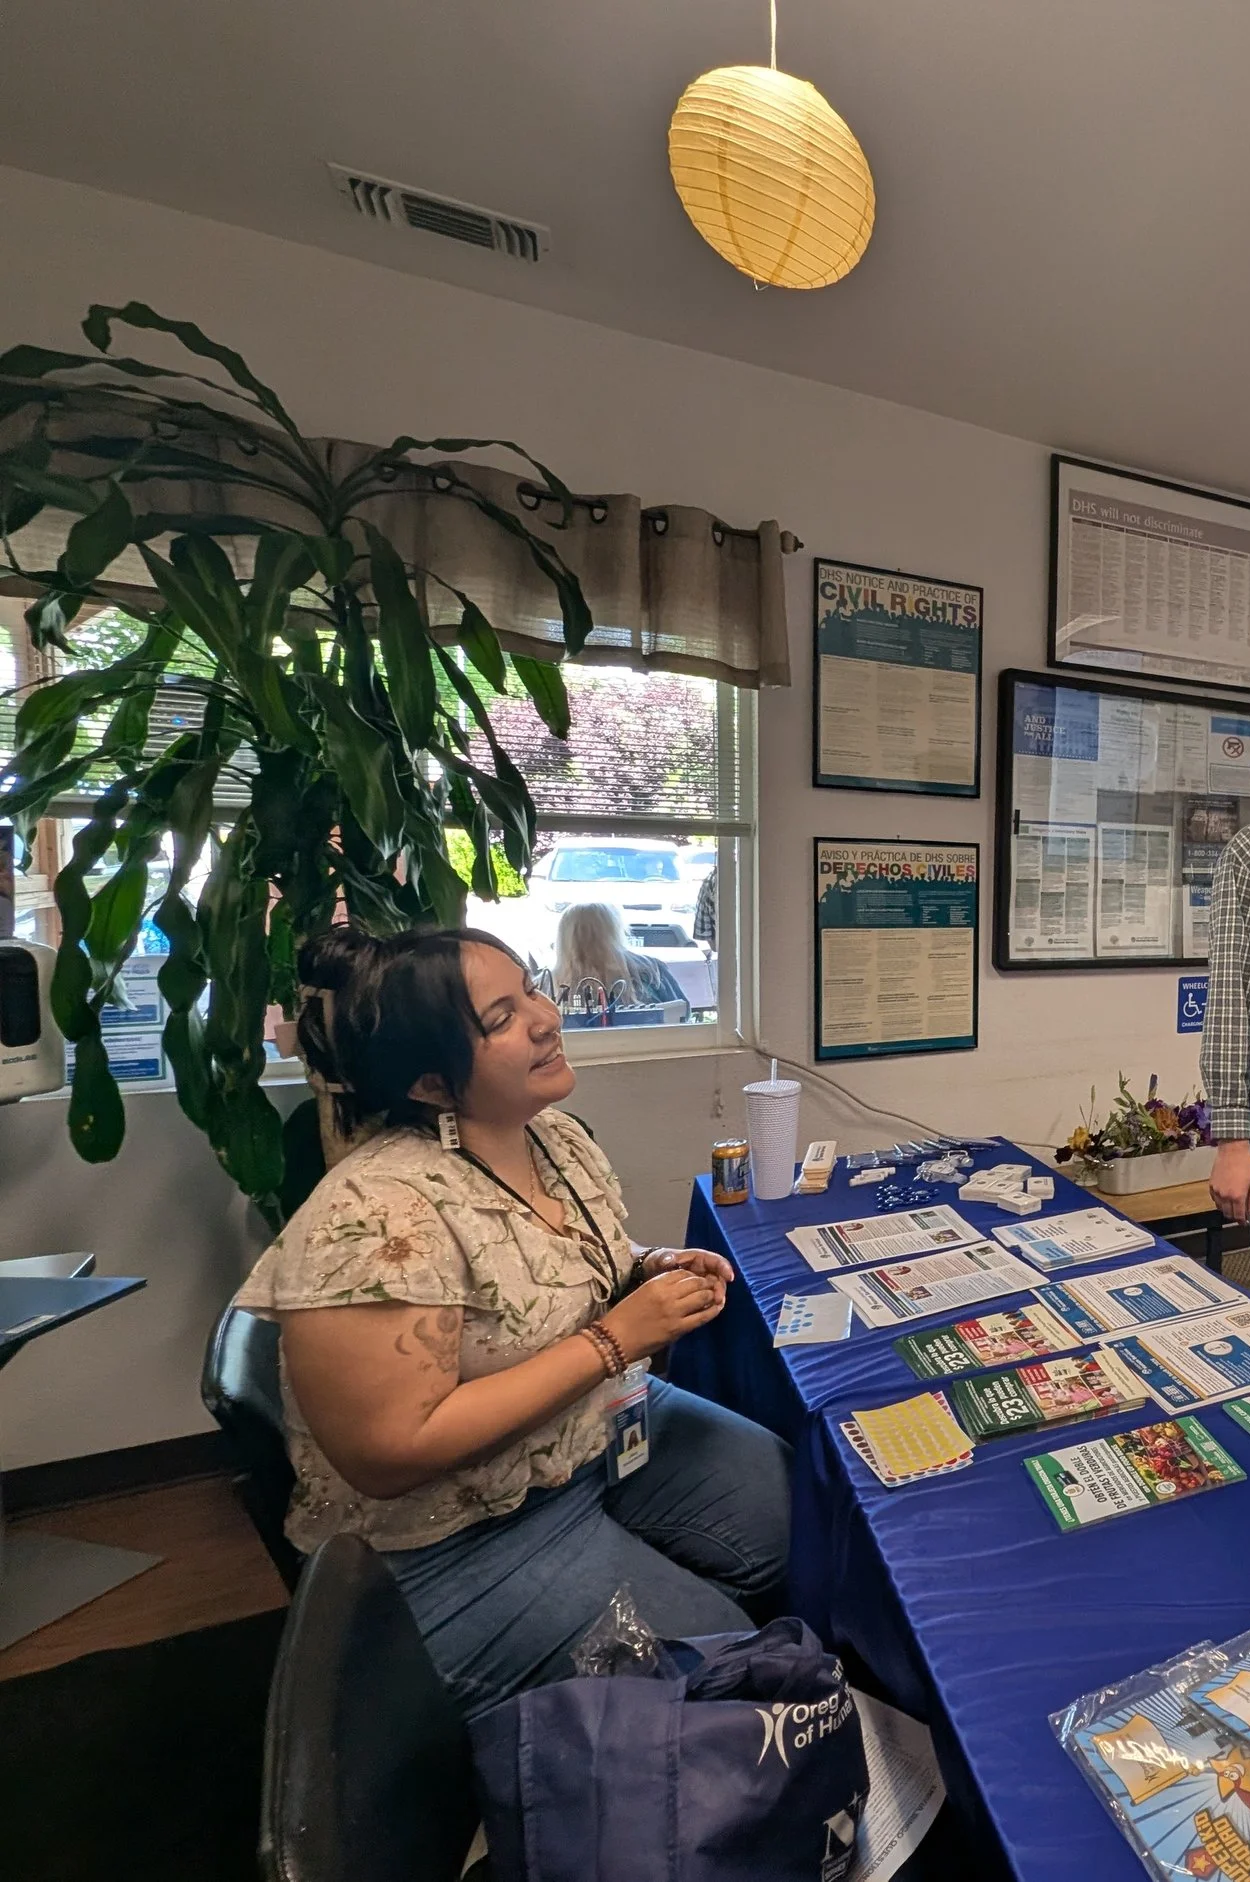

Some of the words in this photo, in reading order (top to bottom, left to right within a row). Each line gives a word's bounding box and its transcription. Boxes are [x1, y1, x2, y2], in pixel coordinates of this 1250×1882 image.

[1073, 498, 1096, 515] DHS
[1101, 506, 1119, 520] will
[1123, 511, 1140, 526] not
[1144, 517, 1204, 539] discriminate
[820, 568, 842, 582] DHS
[846, 572, 884, 589] NOTICE
[887, 580, 909, 593] AND
[913, 584, 960, 602] PRACTICE
[964, 593, 977, 604] OF
[820, 582, 884, 610] CIVIL
[891, 593, 977, 623] RIGHTS
[1024, 715, 1046, 724] AND
[1024, 724, 1065, 734] JUSTICE
[821, 850, 849, 860] AVISO
[852, 850, 857, 859] Y
[861, 849, 907, 861] PRÁCTICA
[910, 852, 922, 862] DE
[925, 852, 943, 863] DHS
[947, 853, 975, 863] SOBRE
[821, 862, 912, 877] DERECHOS
[917, 863, 975, 877] CIVILES
[1191, 885, 1212, 895] Weapo
[925, 1344, 936, 1352] que
[933, 1338, 949, 1353] pueden
[941, 1334, 957, 1351] comprar
[934, 1356, 951, 1374] Descubra
[944, 1352, 969, 1369] $23
[983, 1387, 994, 1397] que
[992, 1381, 1008, 1399] pueden
[1001, 1376, 1017, 1397] comprar
[991, 1402, 1009, 1424] Descubra
[1001, 1398, 1028, 1420] $23
[1070, 1456, 1089, 1475] DOBLE
[1077, 1445, 1102, 1474] VERDURAS
[1082, 1474, 1094, 1482] EL
[1111, 1475, 1128, 1495] MERCADOS
[1130, 1470, 1145, 1486] DOUBLE
[1087, 1482, 1107, 1502] OBTÉN
[1099, 1477, 1120, 1499] FRUTAS
[1126, 1482, 1140, 1498] PUESTOS
[1113, 1499, 1126, 1509] DE
[792, 1692, 838, 1725] Oreg
[794, 1726, 813, 1749] of
[820, 1699, 853, 1739] Huma
[1195, 1811, 1216, 1843] KID
